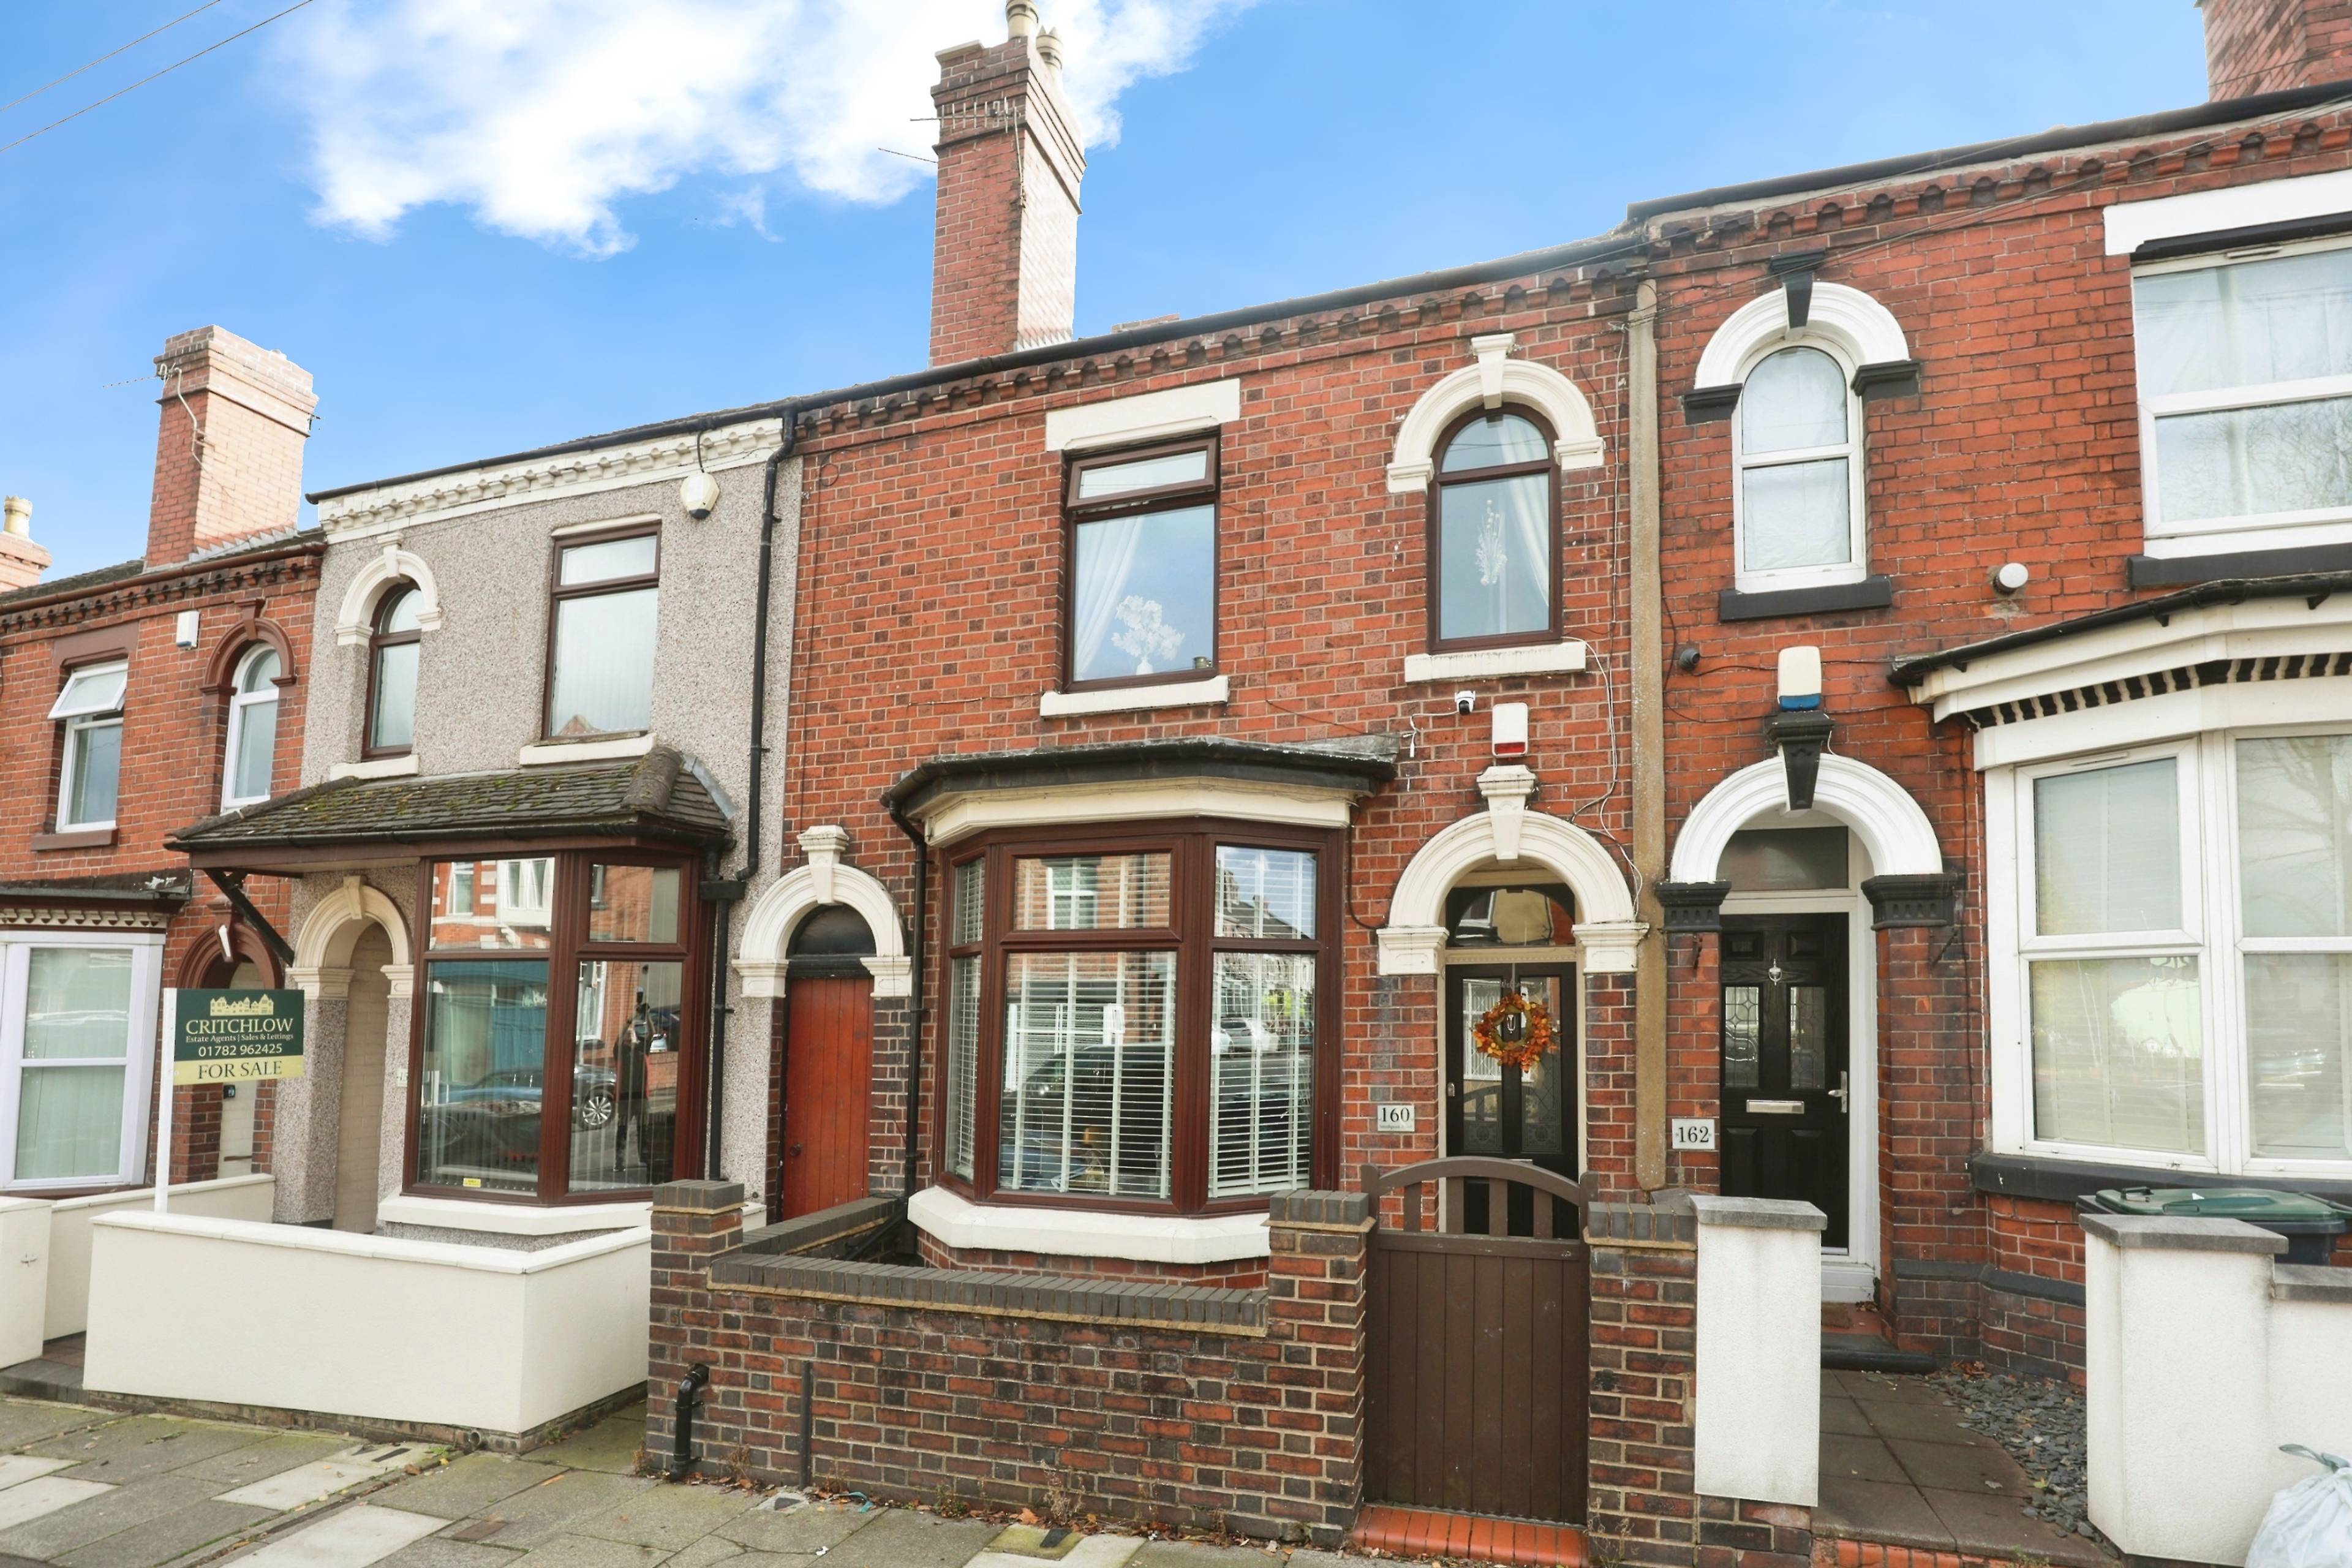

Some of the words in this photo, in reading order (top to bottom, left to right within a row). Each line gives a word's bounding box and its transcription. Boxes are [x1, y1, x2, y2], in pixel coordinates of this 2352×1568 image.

[186, 1019, 293, 1034] CRITCHLOW
[198, 1045, 236, 1057] 01782
[240, 1044, 282, 1055] 962425
[198, 1063, 235, 1079] FOR
[240, 1061, 282, 1077] SALE
[1382, 1107, 1409, 1122] 160
[1678, 1126, 1709, 1143] 162
